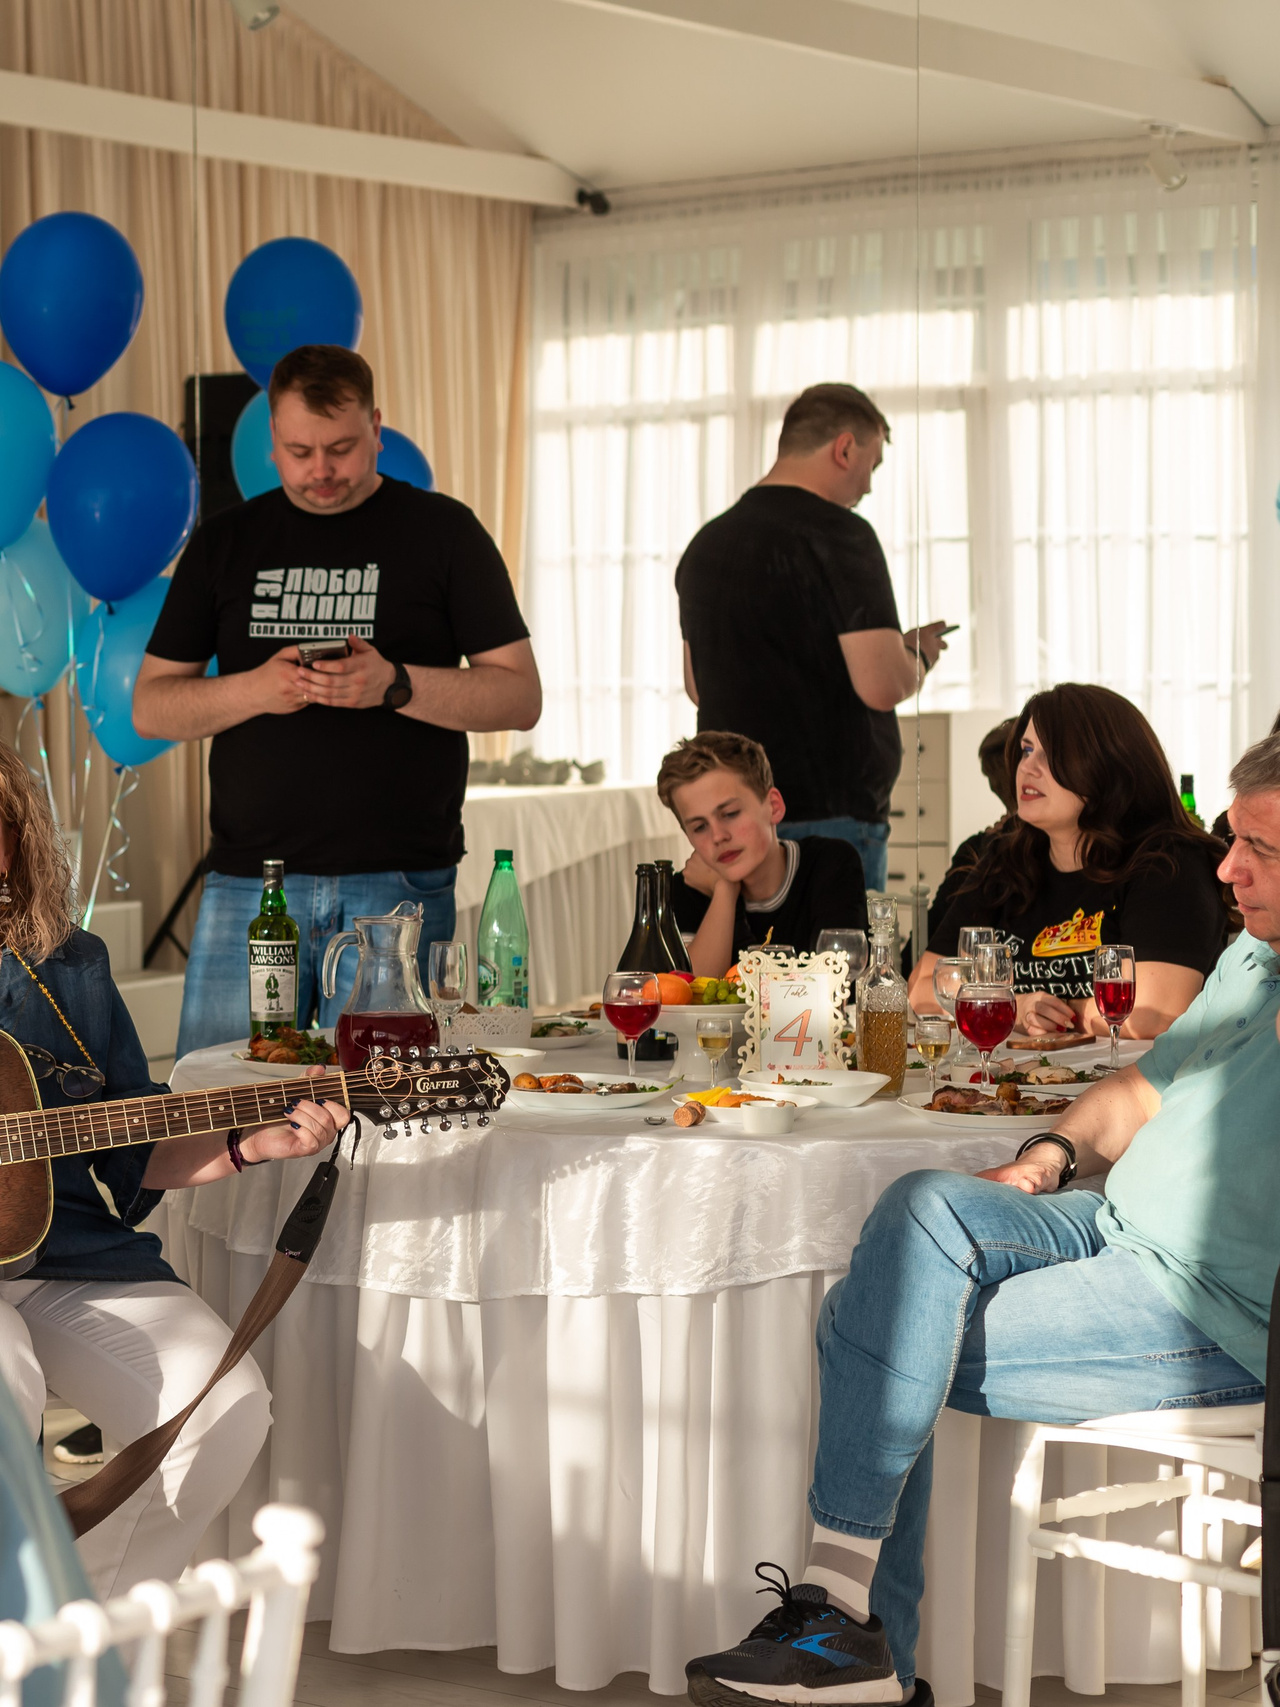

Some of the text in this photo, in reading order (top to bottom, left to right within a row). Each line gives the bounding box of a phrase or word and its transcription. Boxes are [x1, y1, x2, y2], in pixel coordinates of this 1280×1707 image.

[284, 563, 380, 594] ЛЮБОЙ
[251, 569, 284, 619] Я ЗА
[281, 593, 377, 620] КИПИШ
[251, 625, 275, 635] ЕСЛИ
[279, 625, 319, 636] КАТЮХА
[252, 946, 293, 956] WILLIAM
[251, 955, 295, 965] LAWSON'S
[780, 984, 809, 999] Table
[773, 1009, 813, 1057] 4
[416, 1076, 460, 1093] CRAFTER
[798, 1638, 813, 1646] BROOKS
